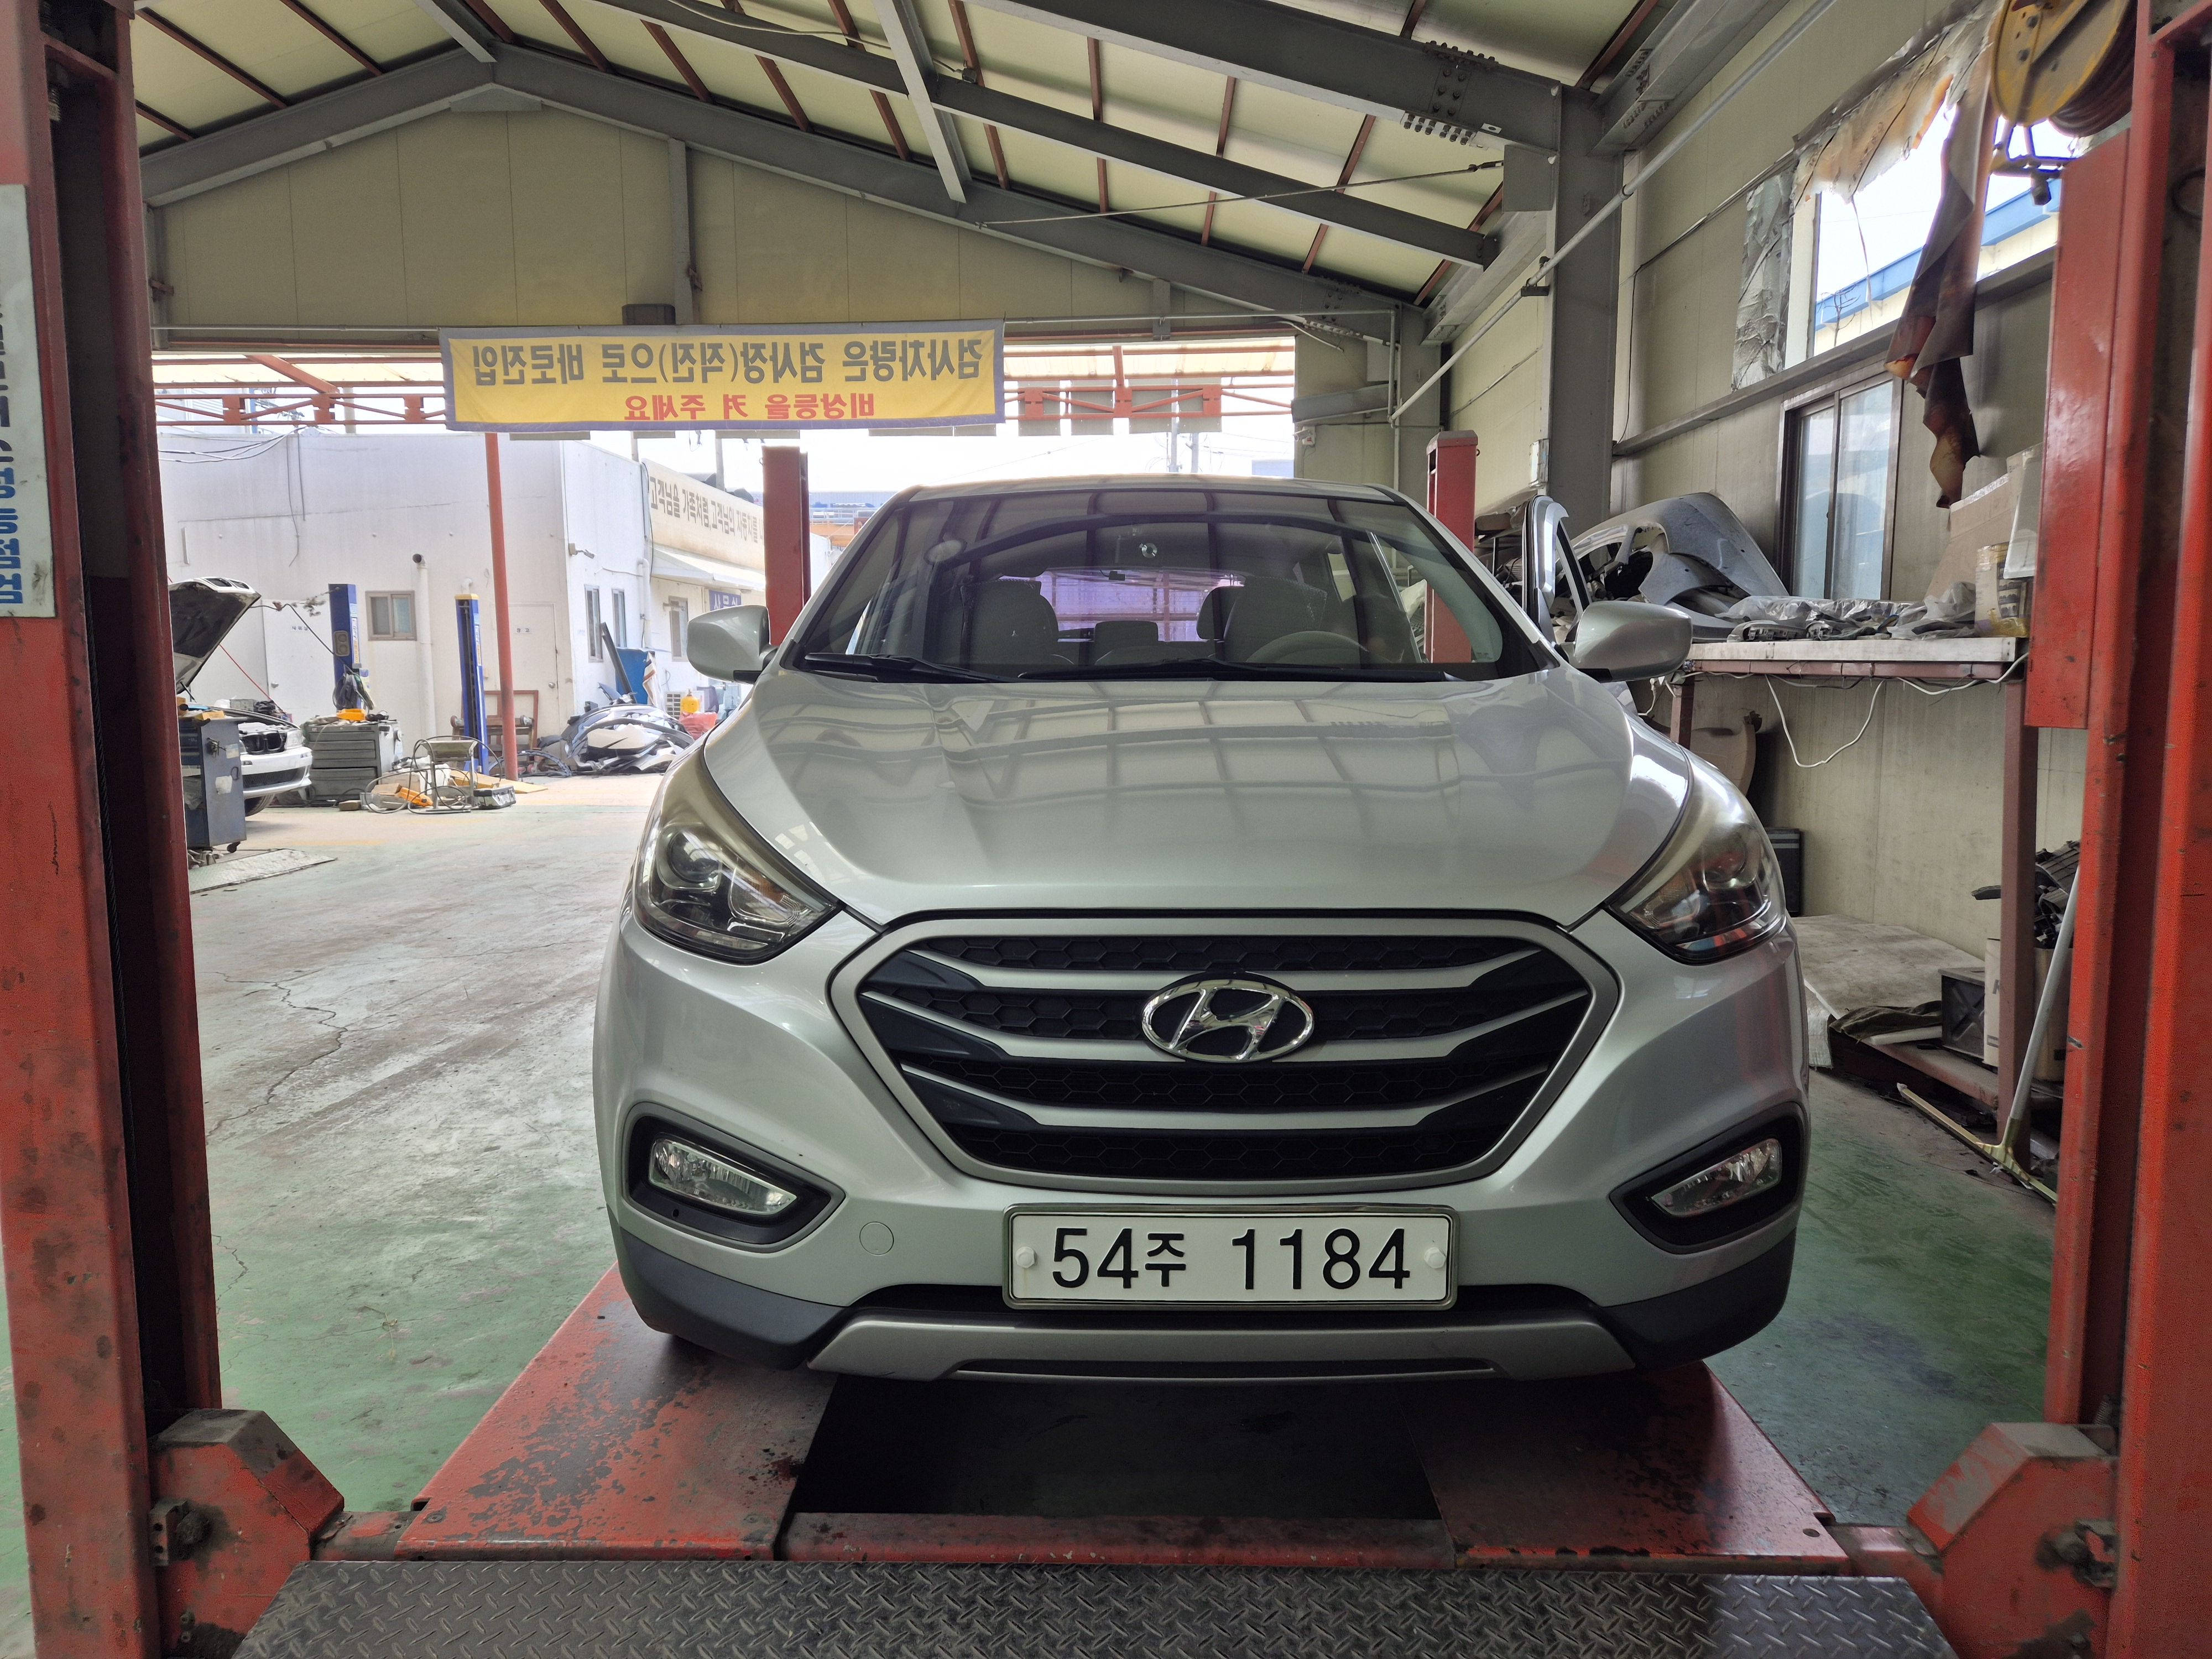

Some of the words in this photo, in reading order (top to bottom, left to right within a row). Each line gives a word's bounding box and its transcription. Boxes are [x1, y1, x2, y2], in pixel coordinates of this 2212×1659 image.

[650, 476, 681, 518] 고객님을
[711, 500, 735, 536] 고객님의
[1052, 1227, 1187, 1289] 54주
[1231, 1228, 1411, 1290] 1184
